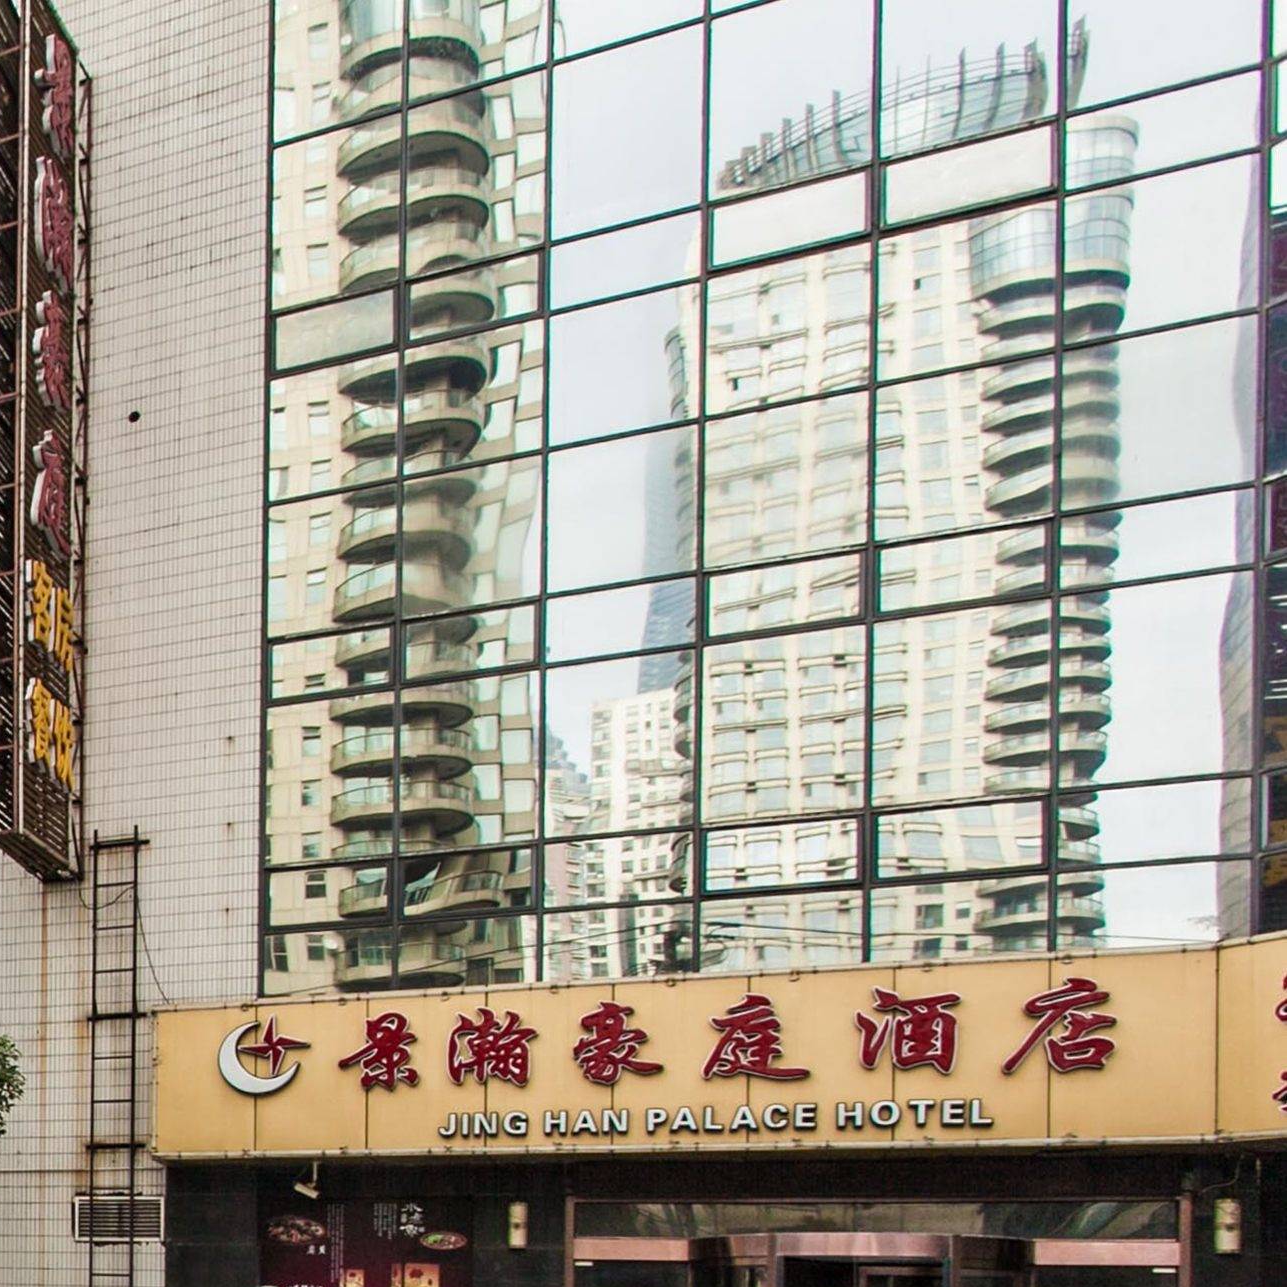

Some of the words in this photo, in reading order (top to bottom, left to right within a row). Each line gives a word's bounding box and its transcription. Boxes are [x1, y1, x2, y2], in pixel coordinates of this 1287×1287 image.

[338, 976, 1120, 1092] 景瀚豪庭酒店
[438, 1111, 529, 1137] JING
[543, 1108, 629, 1134] HAN
[646, 1105, 817, 1131] PALACE
[836, 1100, 995, 1128] HOTEL
